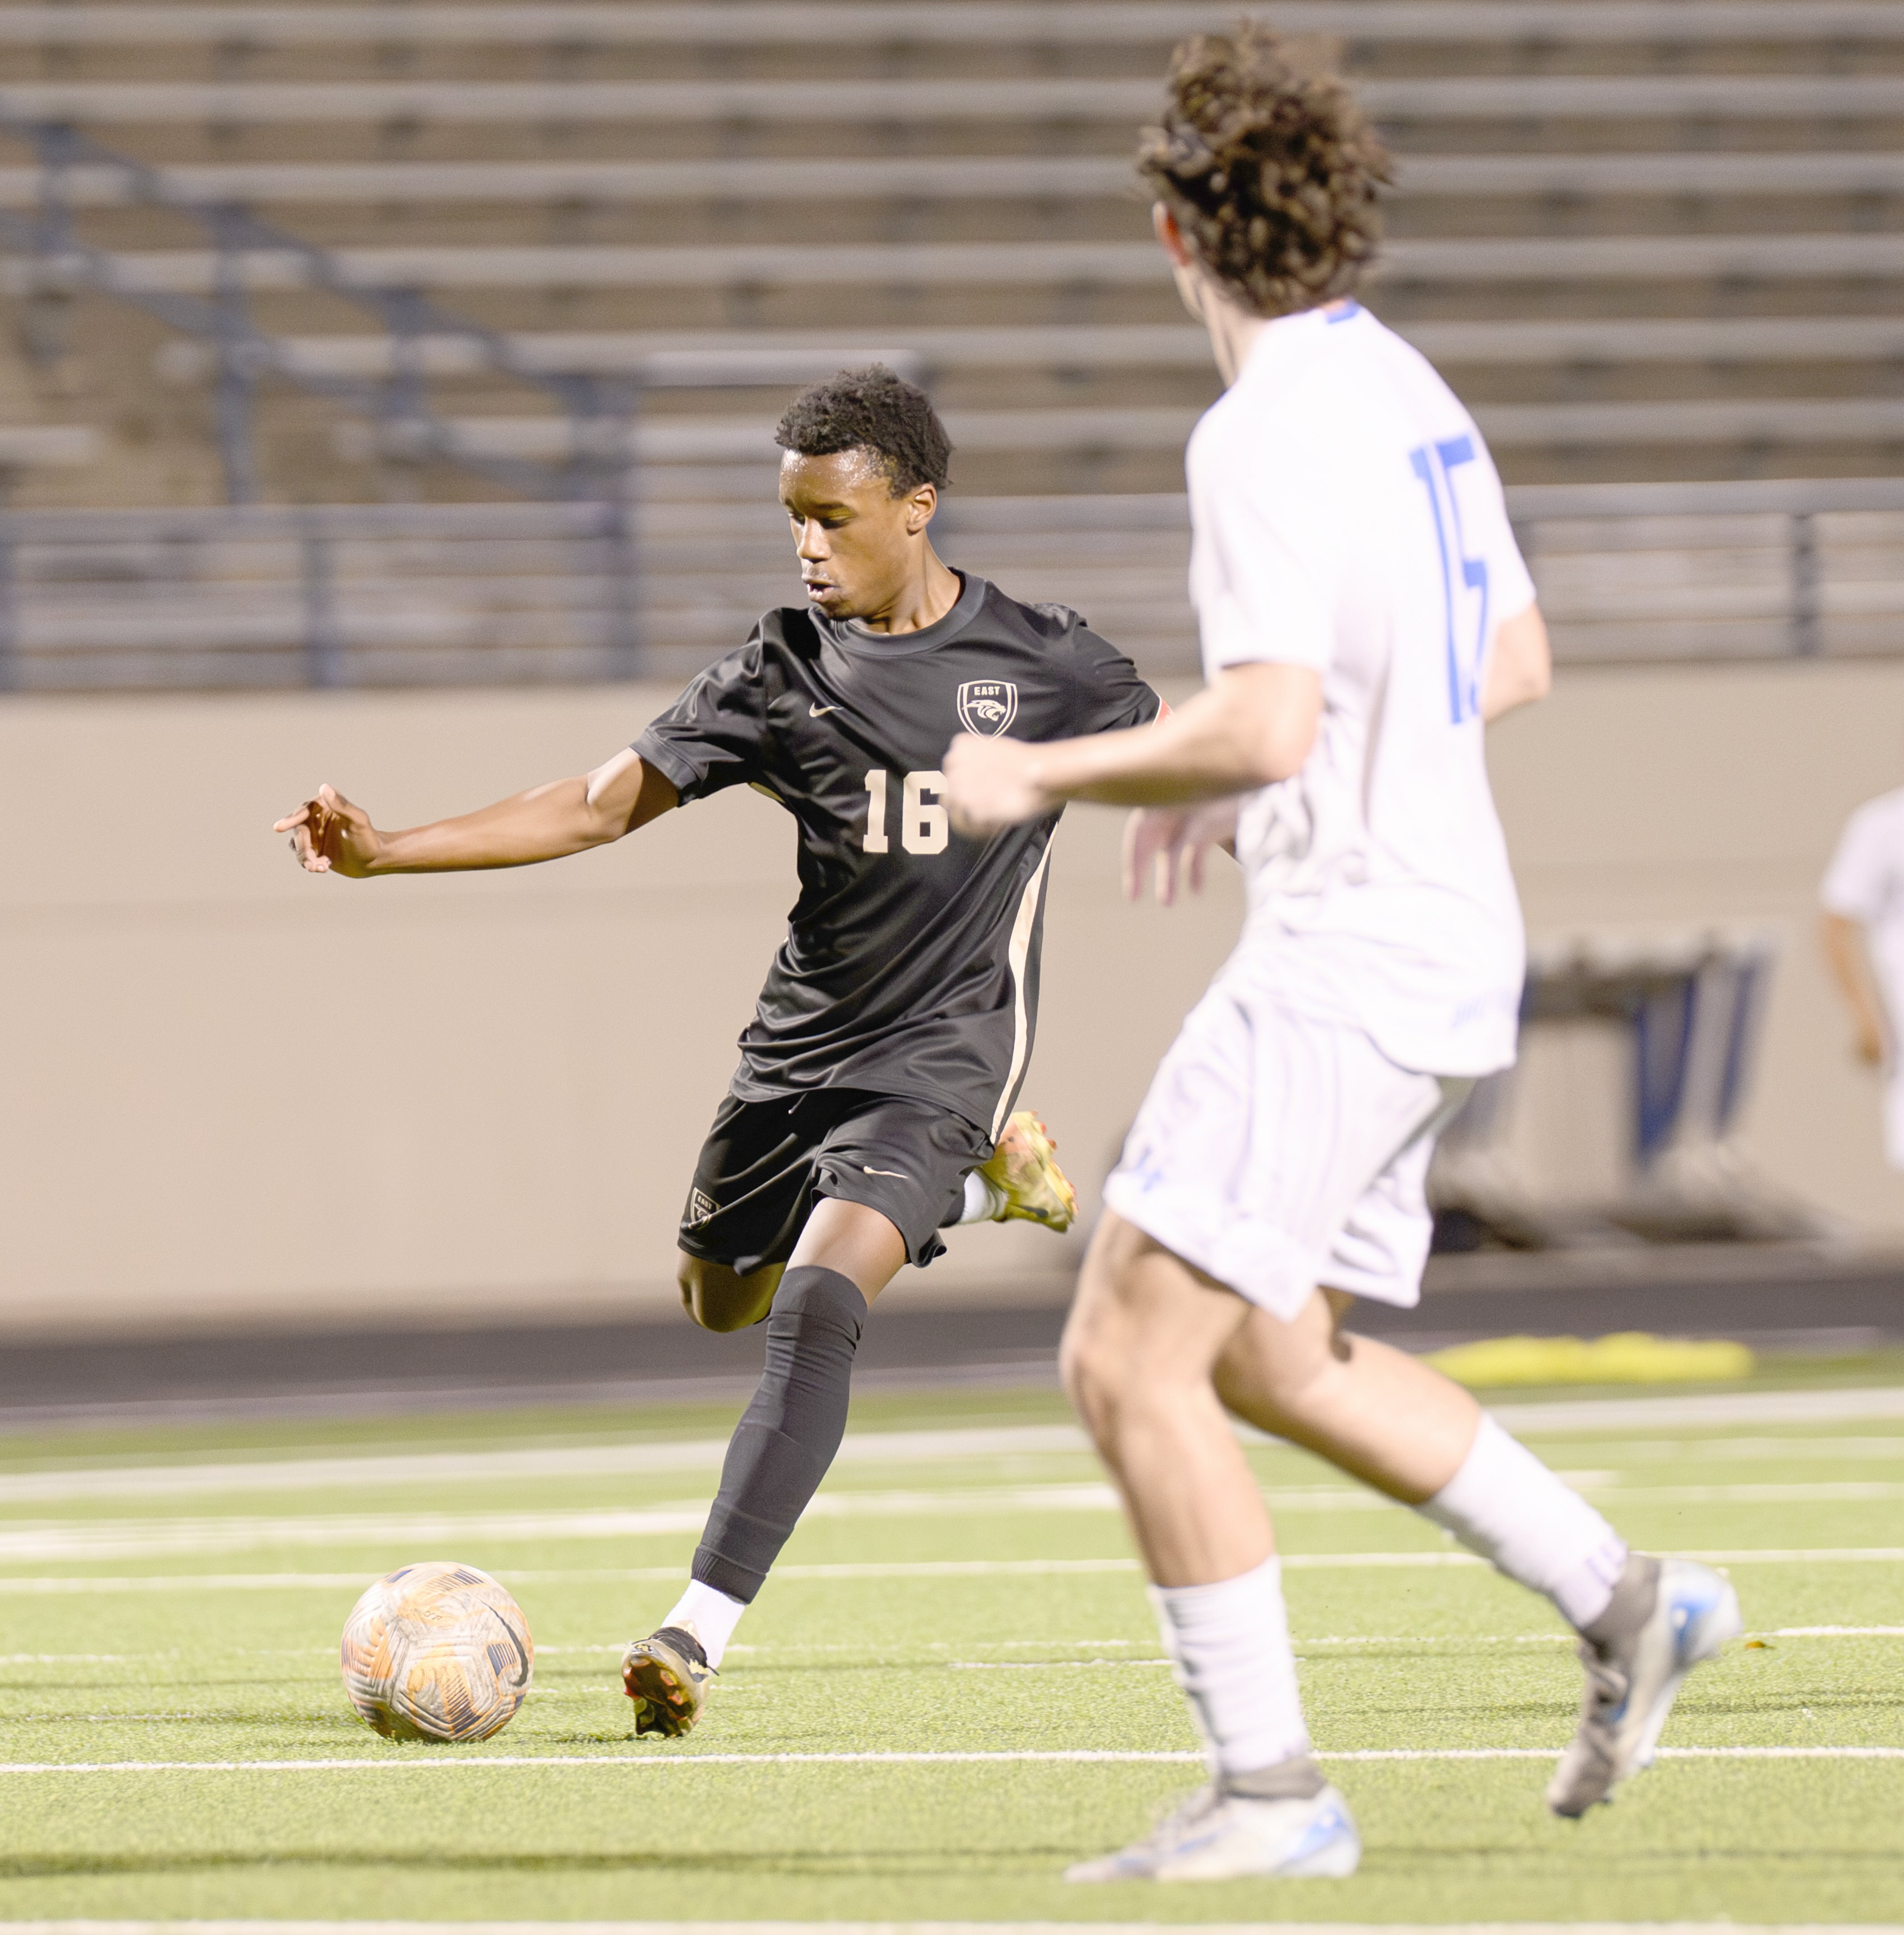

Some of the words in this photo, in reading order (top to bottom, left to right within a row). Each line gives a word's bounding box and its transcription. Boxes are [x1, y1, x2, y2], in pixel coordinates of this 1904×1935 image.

[1409, 434, 1488, 724] 15
[974, 686, 1000, 695] EAST
[863, 769, 949, 854] 16
